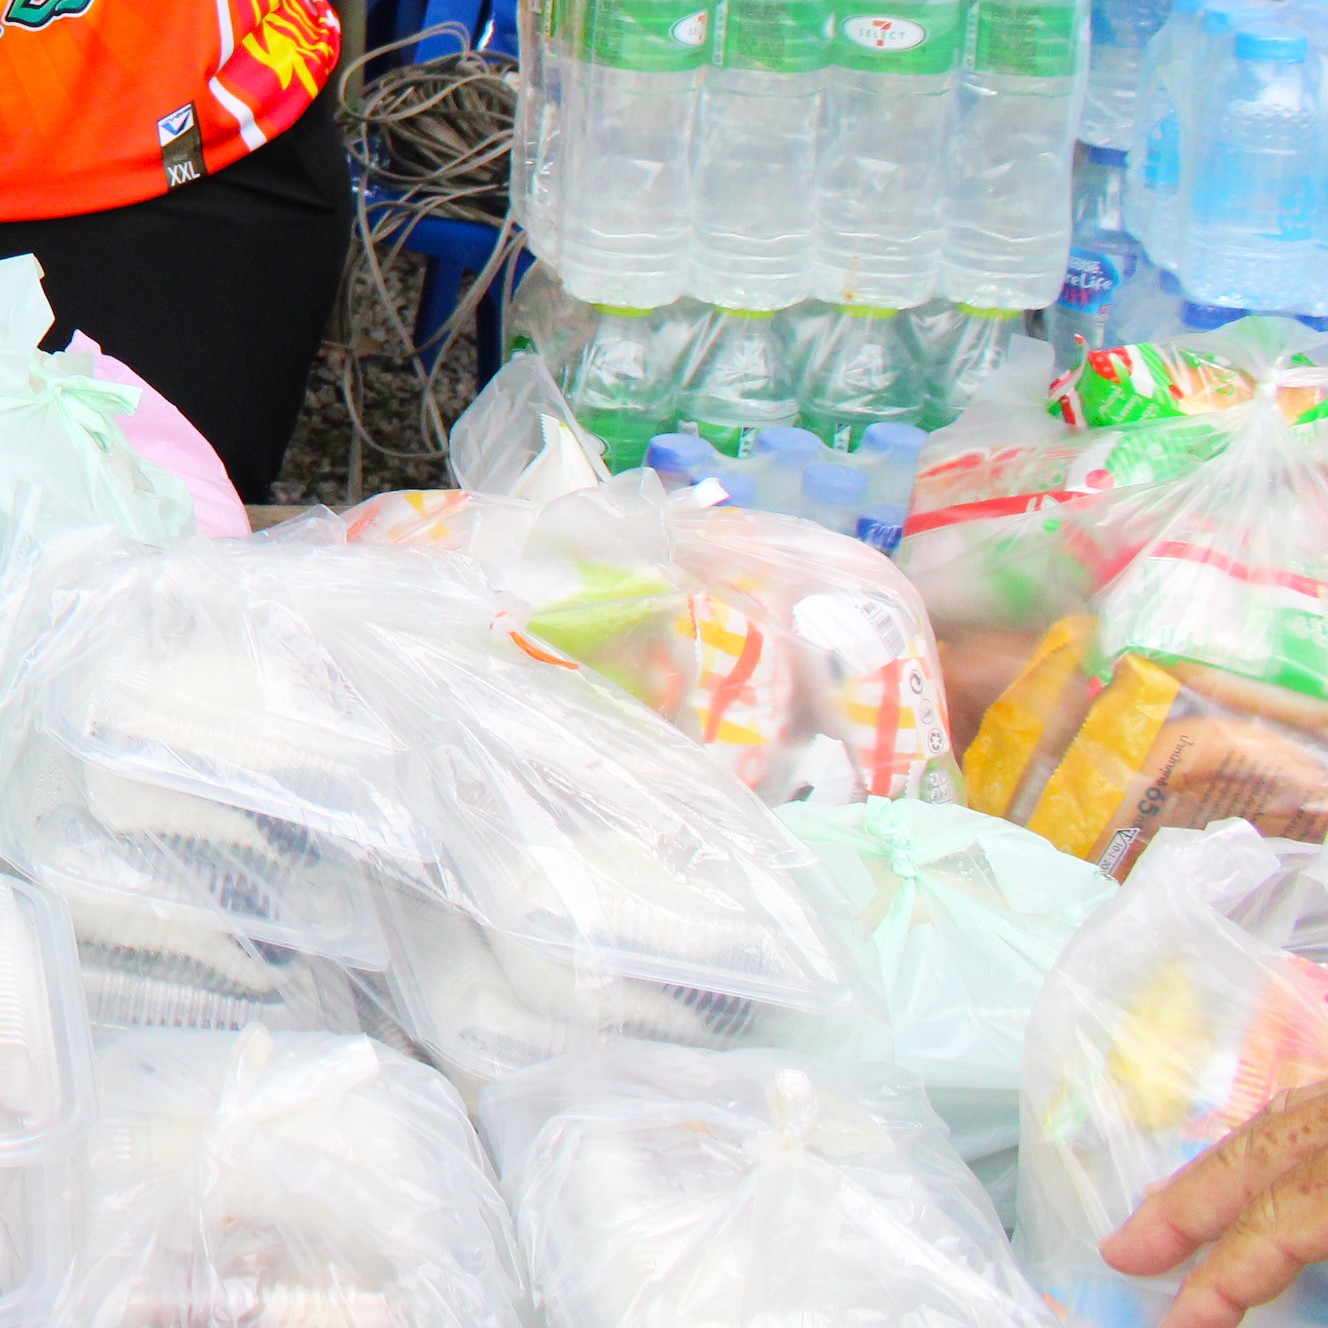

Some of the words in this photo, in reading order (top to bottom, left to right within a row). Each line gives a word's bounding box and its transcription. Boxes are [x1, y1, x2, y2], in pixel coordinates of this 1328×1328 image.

[859, 28, 906, 40] SELECT
[167, 161, 201, 187] XXL
[1138, 787, 1166, 817] 65
